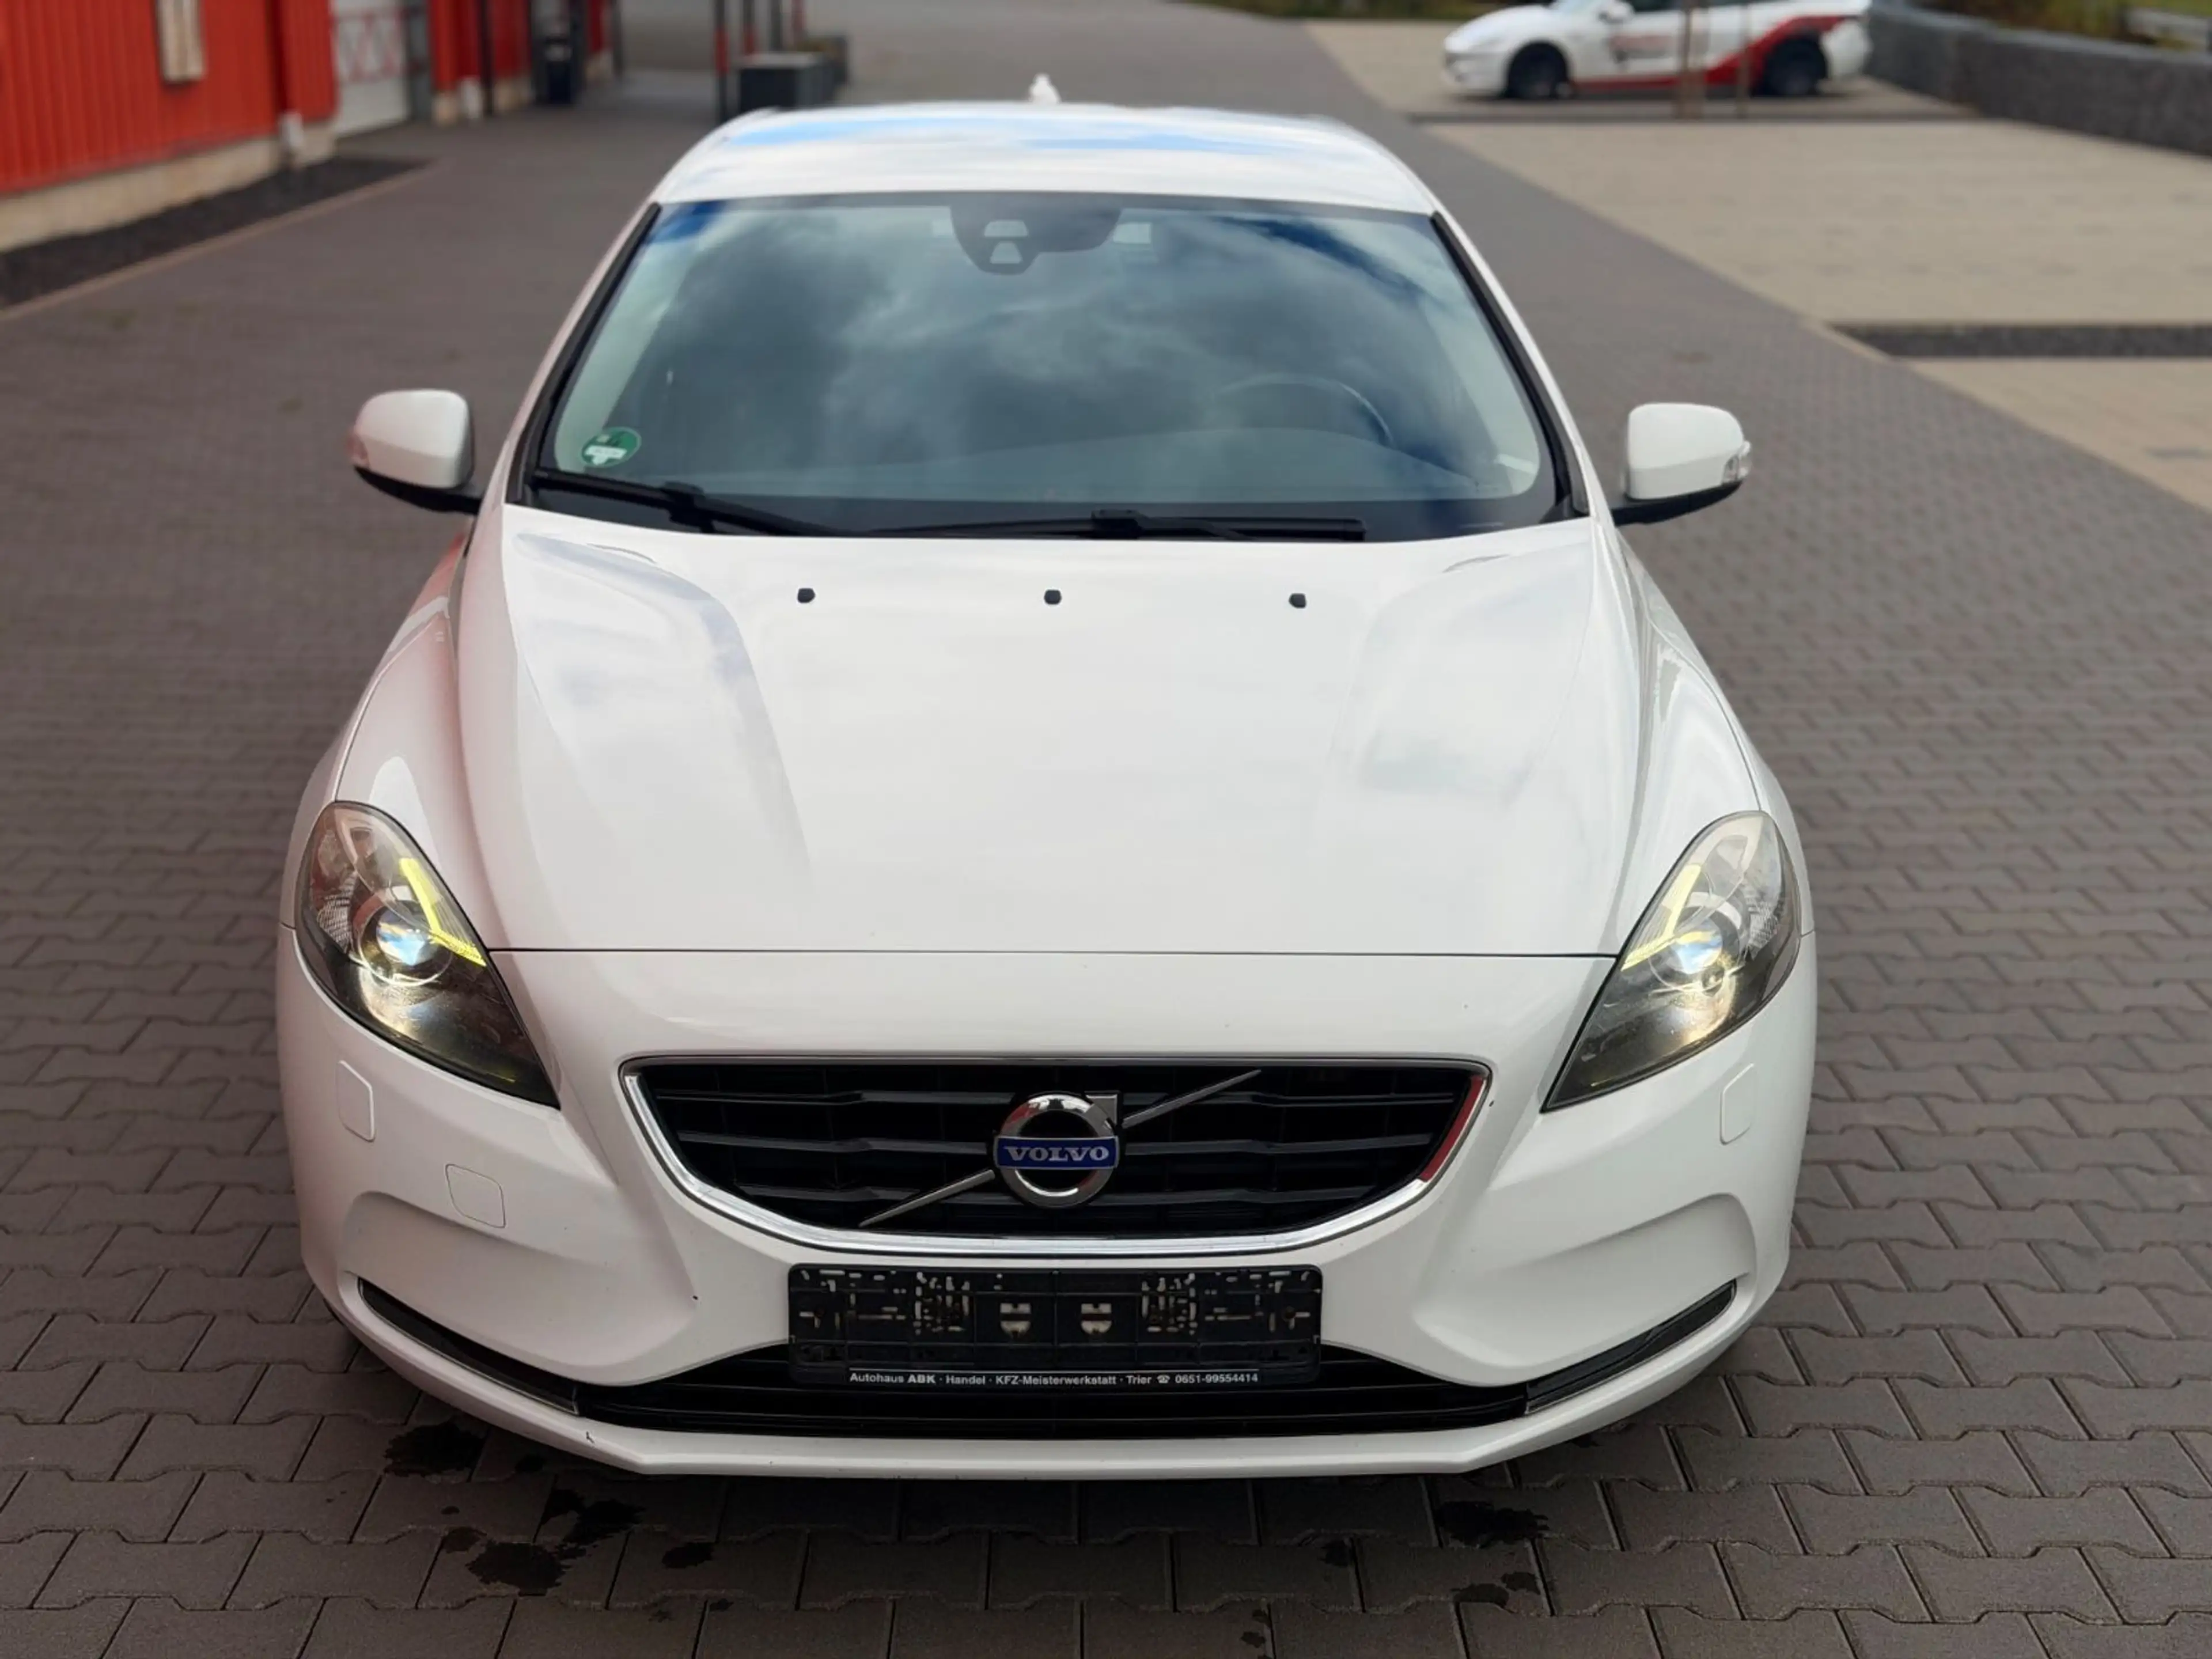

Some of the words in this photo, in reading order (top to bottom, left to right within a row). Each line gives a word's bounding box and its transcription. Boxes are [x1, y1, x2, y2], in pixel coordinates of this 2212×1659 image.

[1003, 1145, 1109, 1161] VOLVO
[850, 1373, 904, 1383] Autohaus
[907, 1374, 936, 1384] ABK
[946, 1375, 986, 1384] Handel
[995, 1376, 1116, 1385] KFZ-Meisterwerkstatt
[1125, 1375, 1152, 1384] Trier
[1175, 1373, 1258, 1384] 0651-99554414
